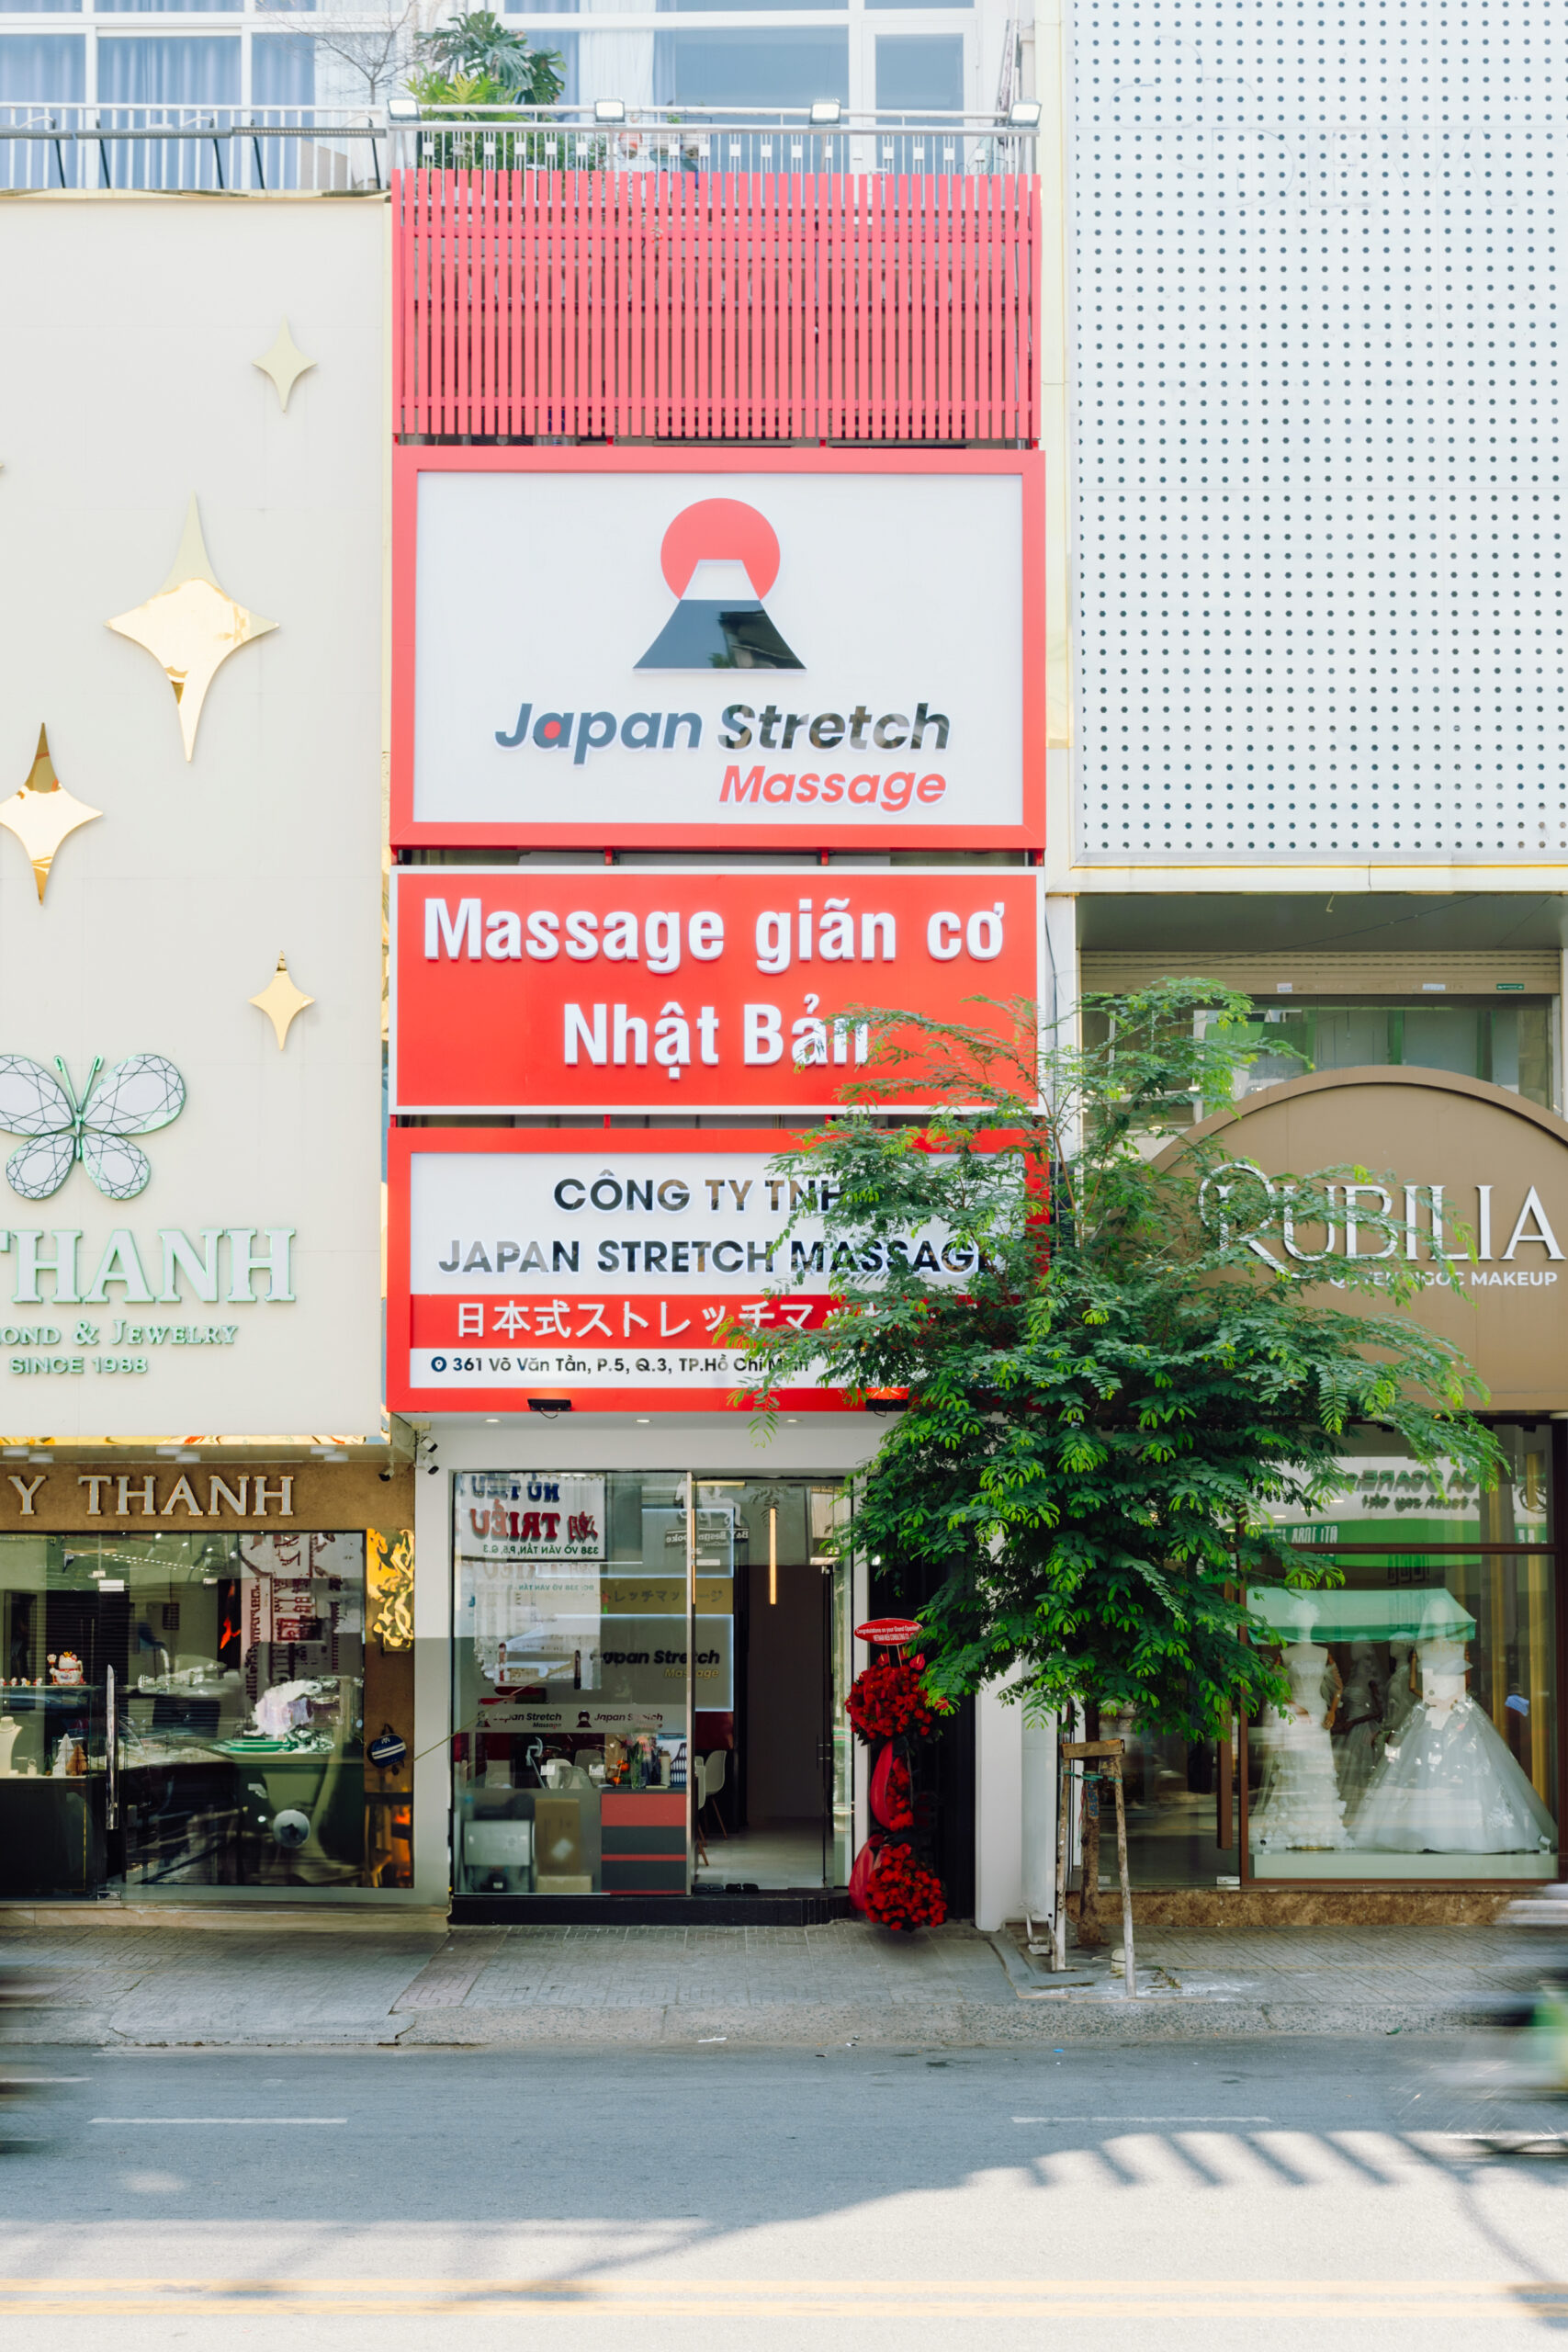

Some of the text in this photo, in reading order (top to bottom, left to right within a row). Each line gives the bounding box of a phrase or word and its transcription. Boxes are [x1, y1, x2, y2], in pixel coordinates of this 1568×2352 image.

[495, 703, 950, 765] Japan Stretch
[719, 764, 946, 812] Massage
[423, 898, 1005, 974] Massage giãn cơ
[564, 993, 869, 1080] Nhật Bản
[554, 1170, 690, 1212] CÔNG
[704, 1179, 753, 1211] TY
[1198, 1163, 1567, 1279] RUBILIA
[0, 1227, 296, 1304] HANH
[439, 1239, 580, 1274] JAPAN
[598, 1239, 773, 1274] STRETCH
[1471, 1272, 1558, 1286] MAKEUP
[0, 1325, 62, 1346] OND
[73, 1319, 99, 1345] &
[9, 1355, 149, 1375] SINCE 1988
[453, 1357, 482, 1373] 361
[489, 1356, 512, 1373] Võ
[517, 1357, 549, 1373] Văn
[555, 1354, 592, 1374] Tần,
[597, 1357, 631, 1374] P.5,
[636, 1358, 672, 1374] Q.3,
[679, 1354, 729, 1372] TP.Hồ
[7, 1476, 295, 1517] Y THANH
[653, 1649, 721, 1665] Strech
[526, 1713, 562, 1721] Stretch
[594, 1713, 626, 1723] Japan
